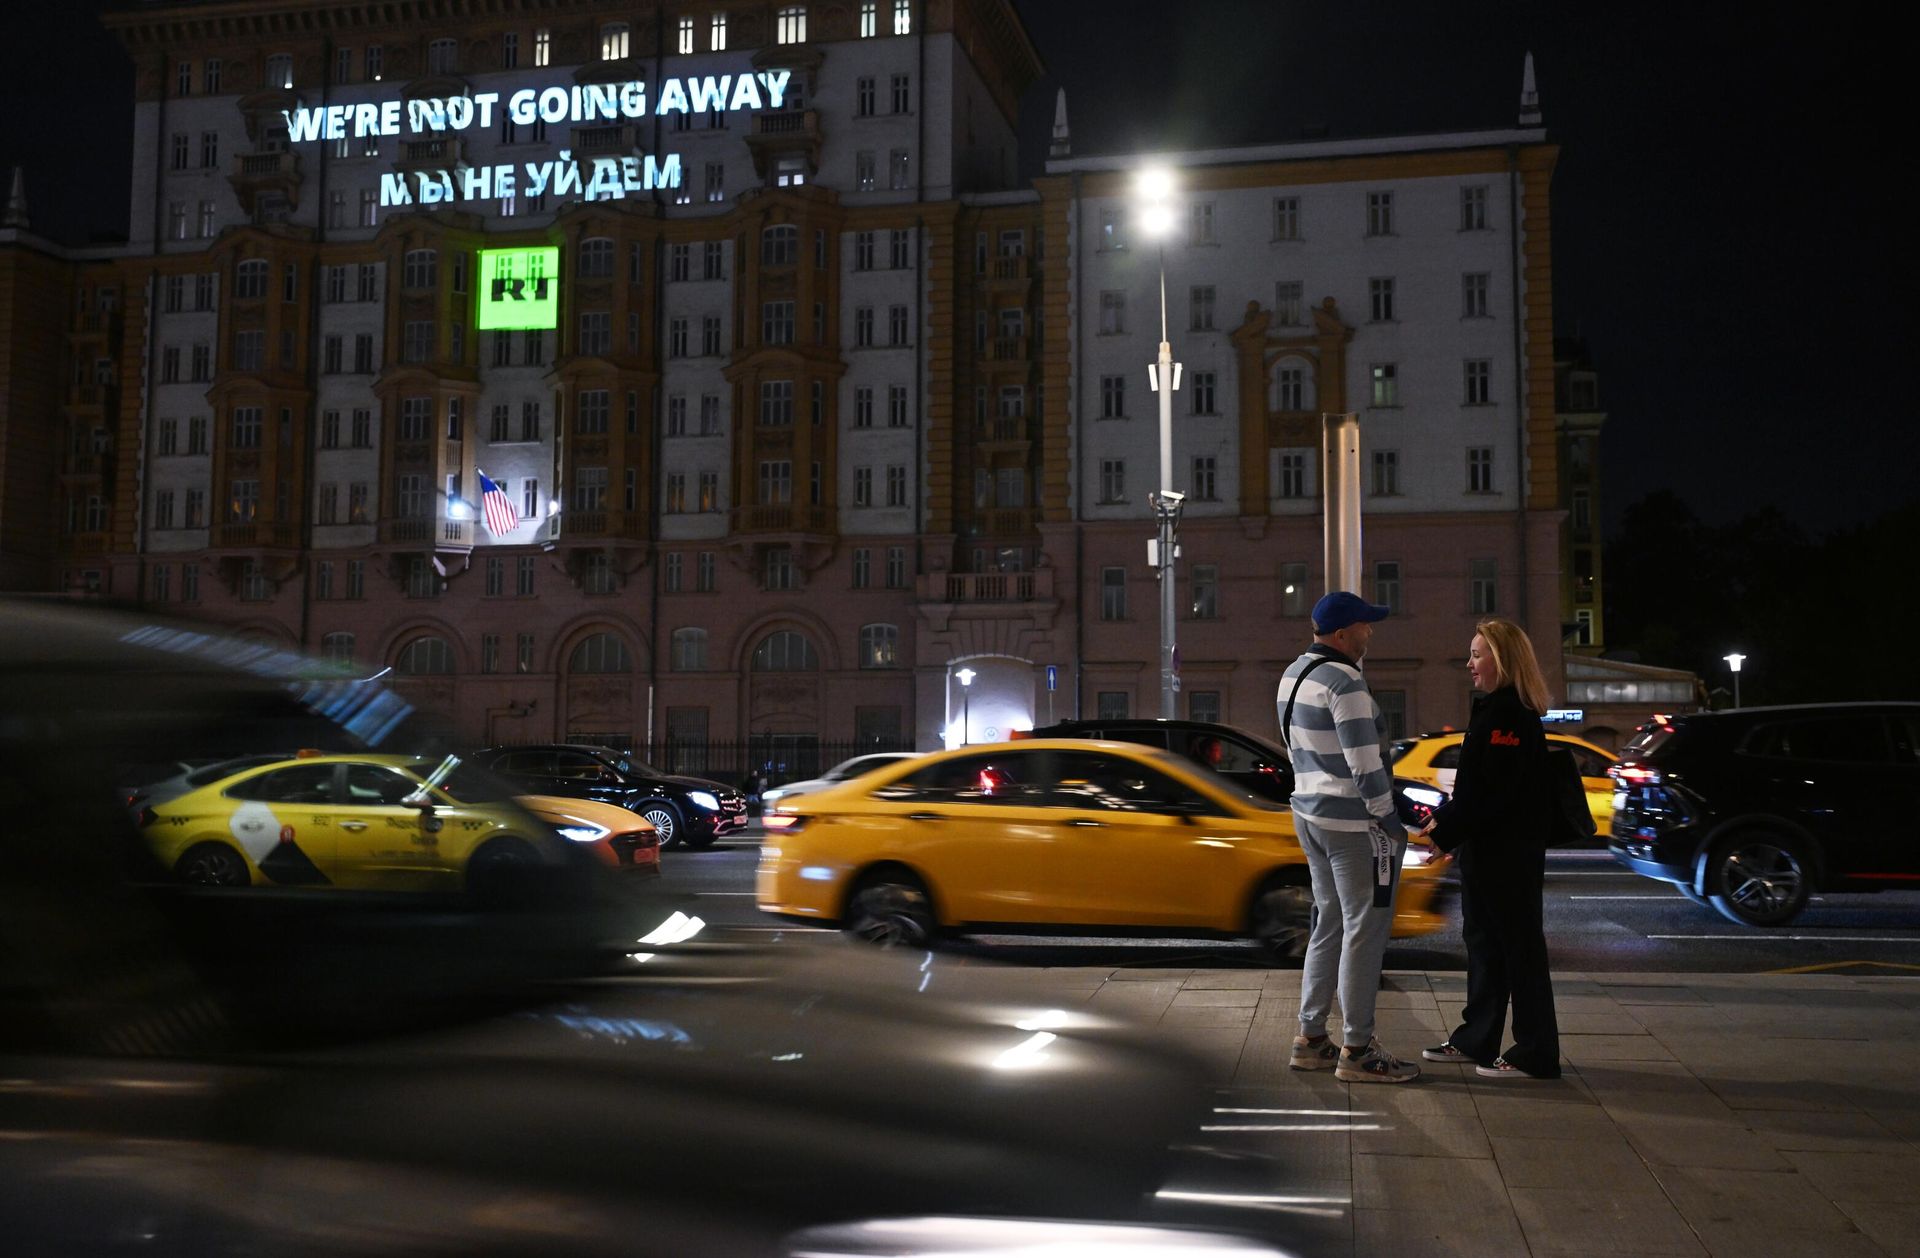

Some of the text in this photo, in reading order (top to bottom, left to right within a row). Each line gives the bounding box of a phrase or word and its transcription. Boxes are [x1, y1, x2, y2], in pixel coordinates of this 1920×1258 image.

[282, 70, 791, 143] WE'RE NOT GOING AWAY
[380, 169, 455, 207] МЫ
[463, 164, 516, 200] НЕ
[1378, 835, 1388, 854] POLO
